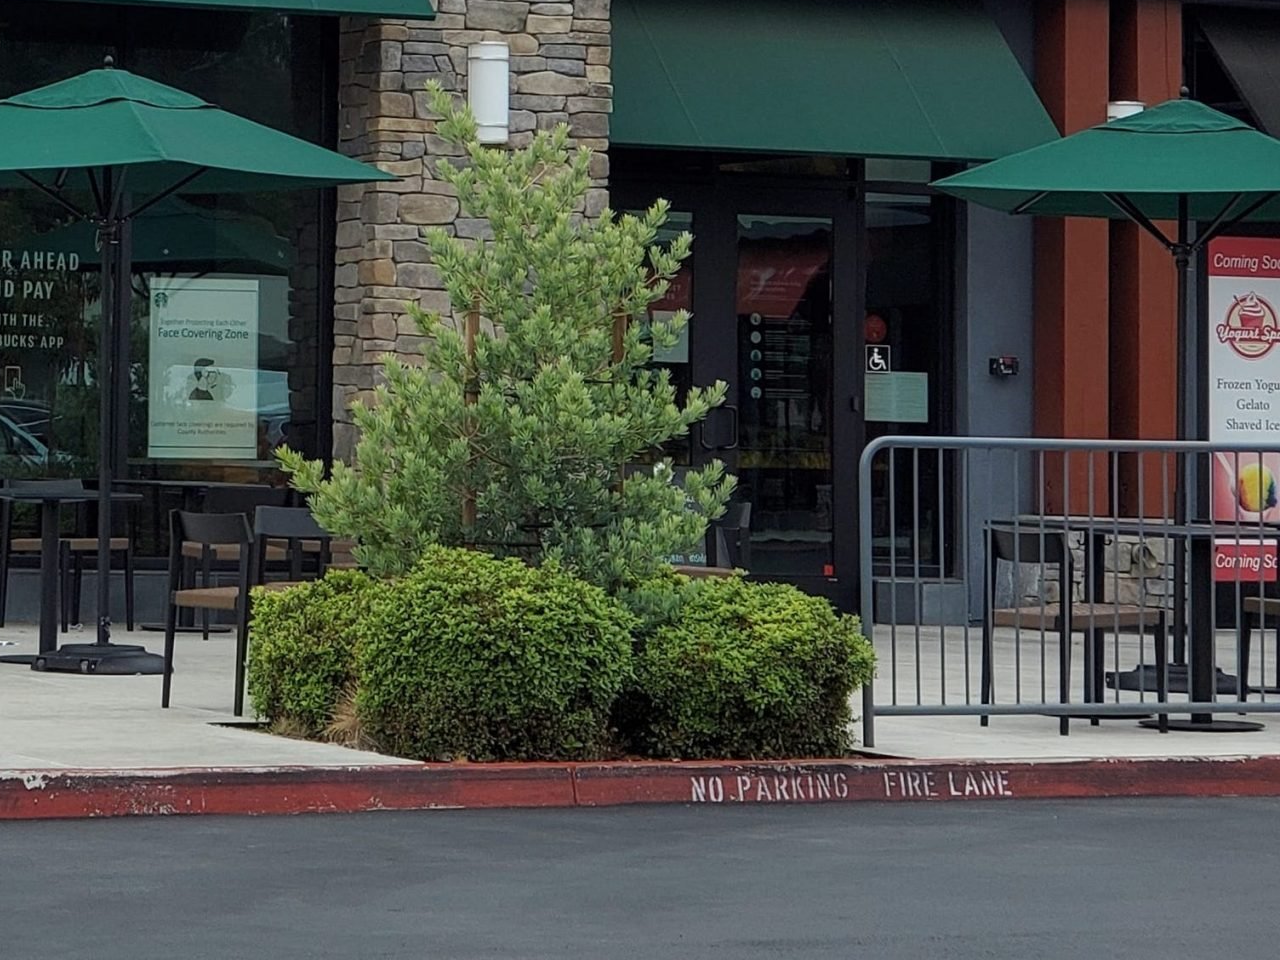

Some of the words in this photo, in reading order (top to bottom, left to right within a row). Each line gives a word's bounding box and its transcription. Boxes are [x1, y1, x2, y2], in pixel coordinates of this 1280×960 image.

[20, 250, 79, 271] AHEAD
[1213, 253, 1259, 272] Coming
[23, 280, 54, 299] PAY
[22, 313, 44, 327] THE
[40, 335, 64, 348] APP
[158, 327, 180, 338] Face
[181, 328, 223, 341] Covering
[224, 328, 249, 339] Zone
[1217, 325, 1260, 343] Yogurt
[1216, 377, 1253, 390] Frozen
[1235, 398, 1271, 410] Gelato
[1225, 417, 1262, 430] Shaved
[1265, 419, 1280, 431] Ice
[1215, 552, 1261, 572] Coming
[691, 776, 723, 802] NO
[737, 772, 848, 802] PARKING
[884, 771, 939, 797] FIRE
[948, 770, 1012, 796] LANE
